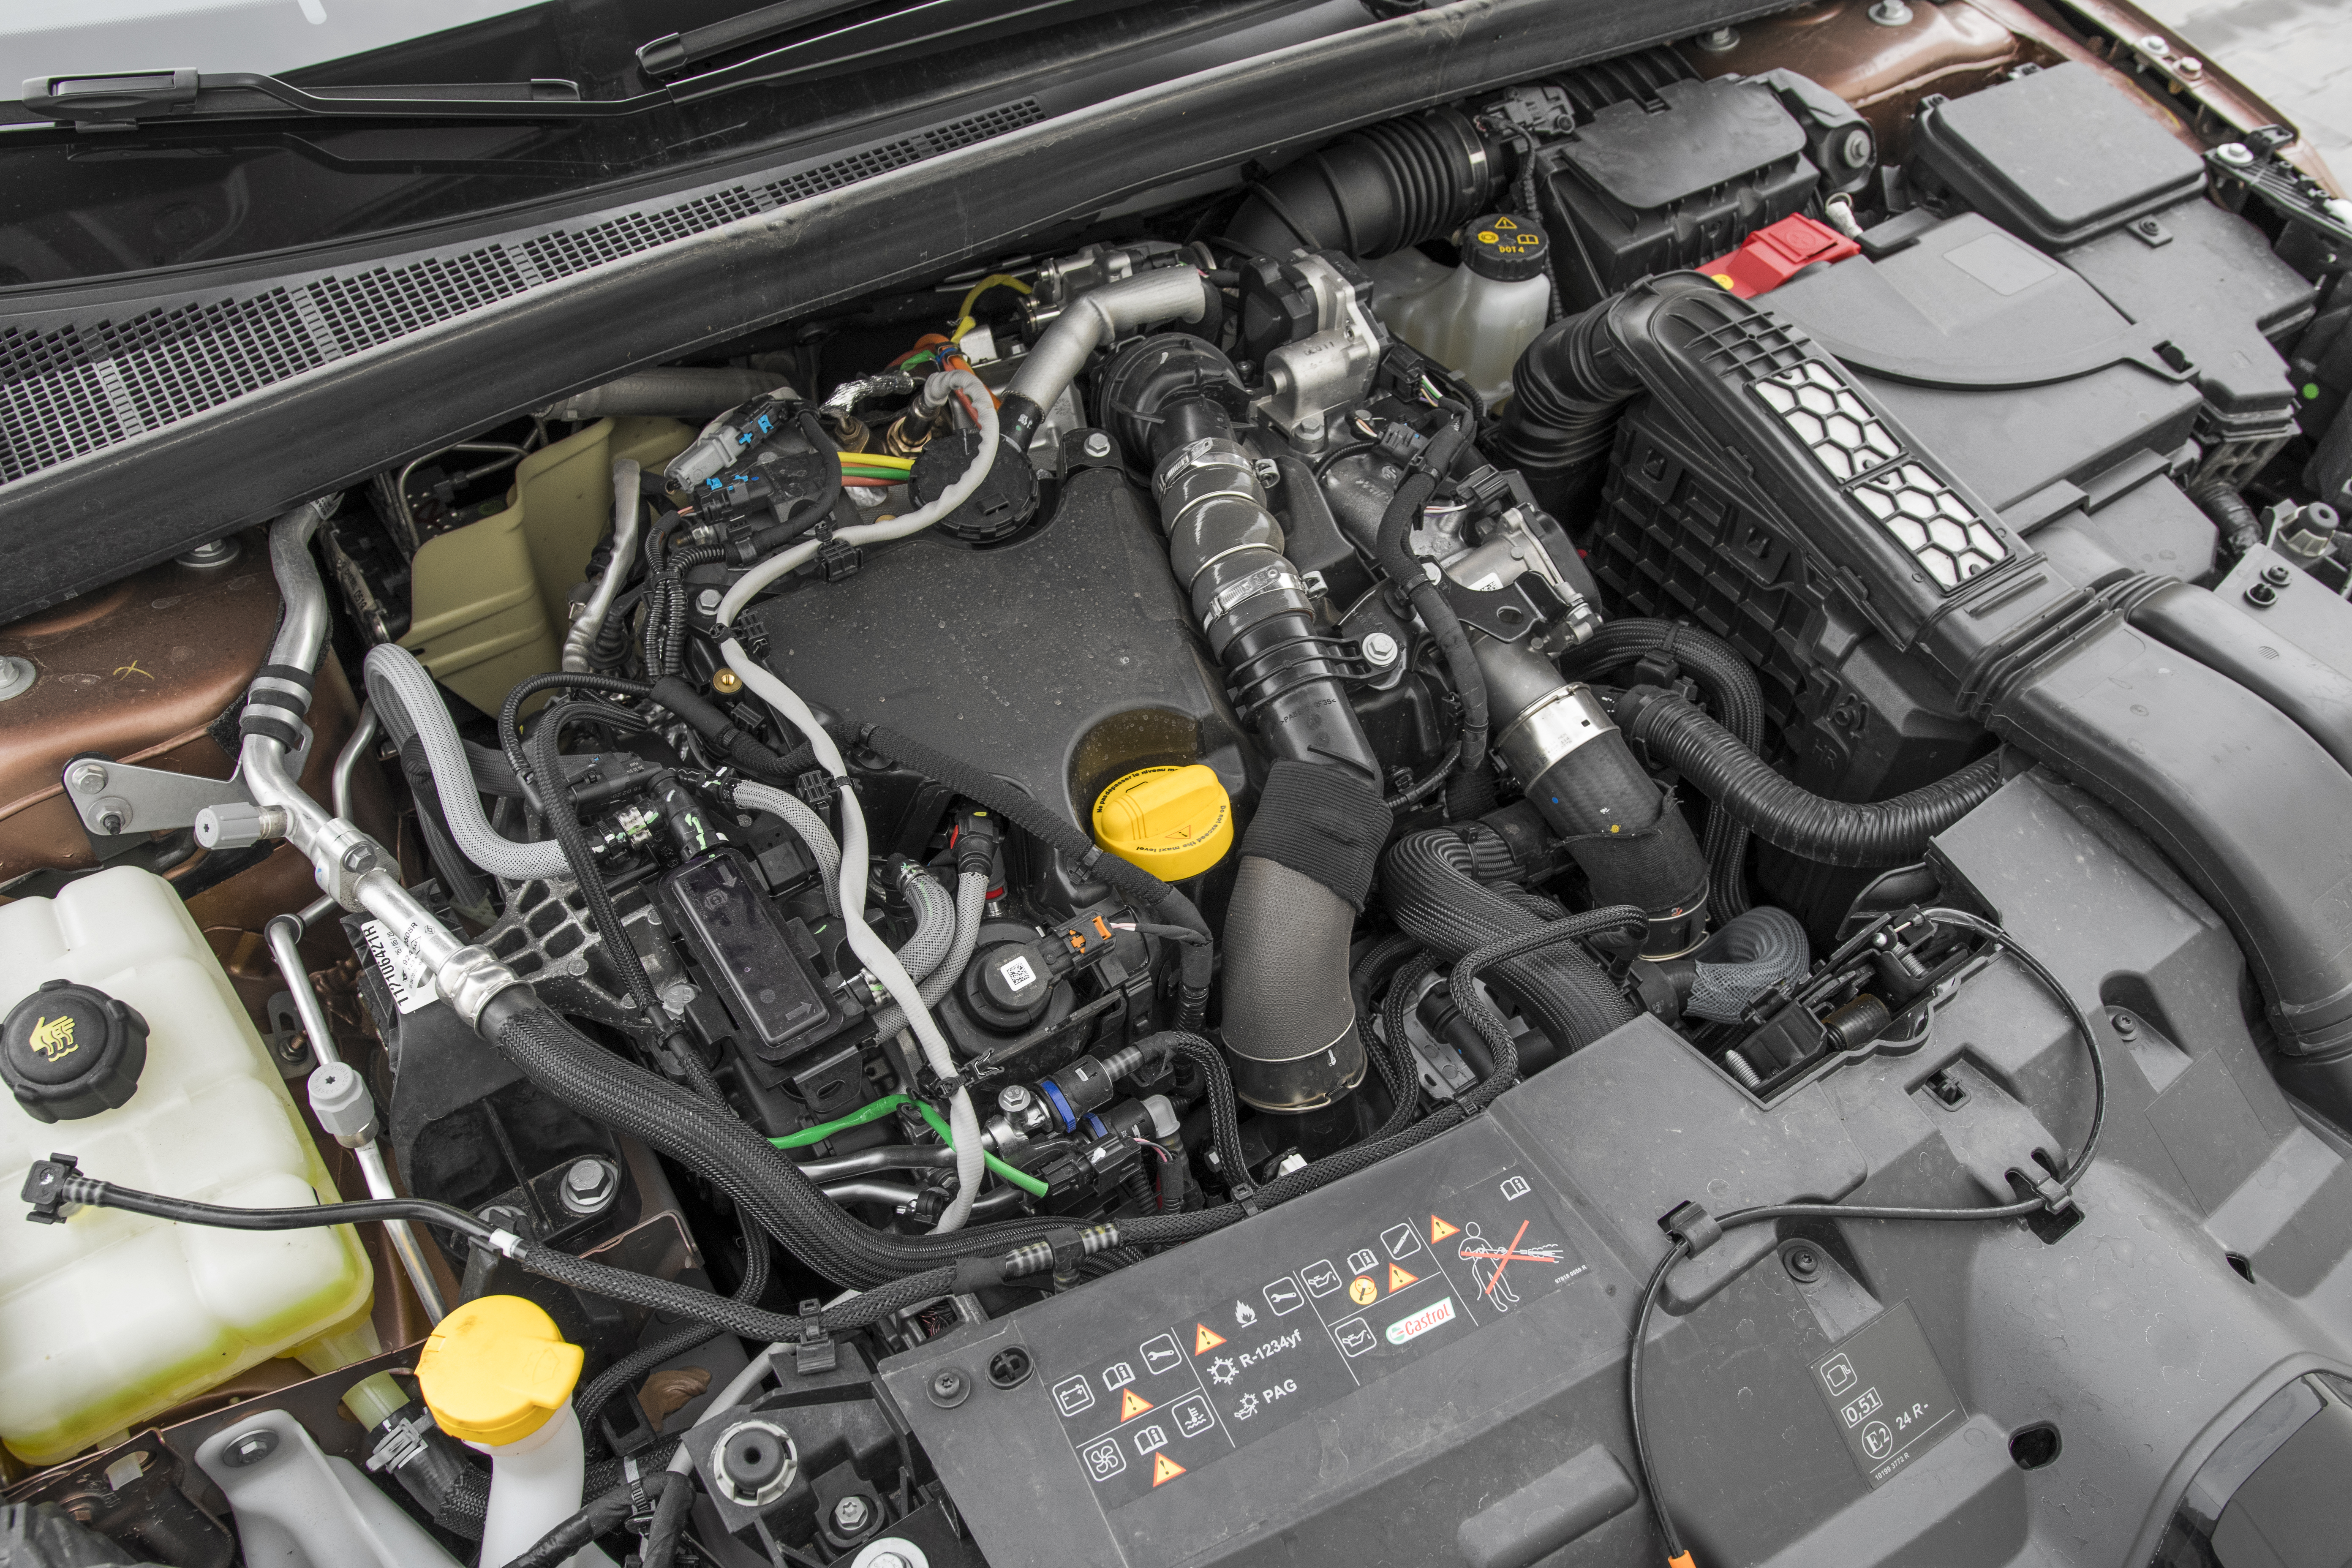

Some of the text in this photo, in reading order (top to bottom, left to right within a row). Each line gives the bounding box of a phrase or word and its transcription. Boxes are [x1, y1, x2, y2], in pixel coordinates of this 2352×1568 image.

[1105, 776, 1132, 795] dépasser
[1196, 824, 1218, 843] exceed
[363, 926, 409, 1007] 112106421R
[1554, 1273, 1570, 1284] 97818
[1570, 1267, 1582, 1276] 0559
[1405, 1304, 1451, 1335] Castrol
[1239, 1328, 1302, 1367] R-1234yf
[1262, 1379, 1297, 1405] PAG
[1846, 1393, 1879, 1422] 0,51
[1895, 1411, 1911, 1430] 24
[1875, 1466, 1891, 1481] 10199
[1891, 1456, 1904, 1469] 3772
